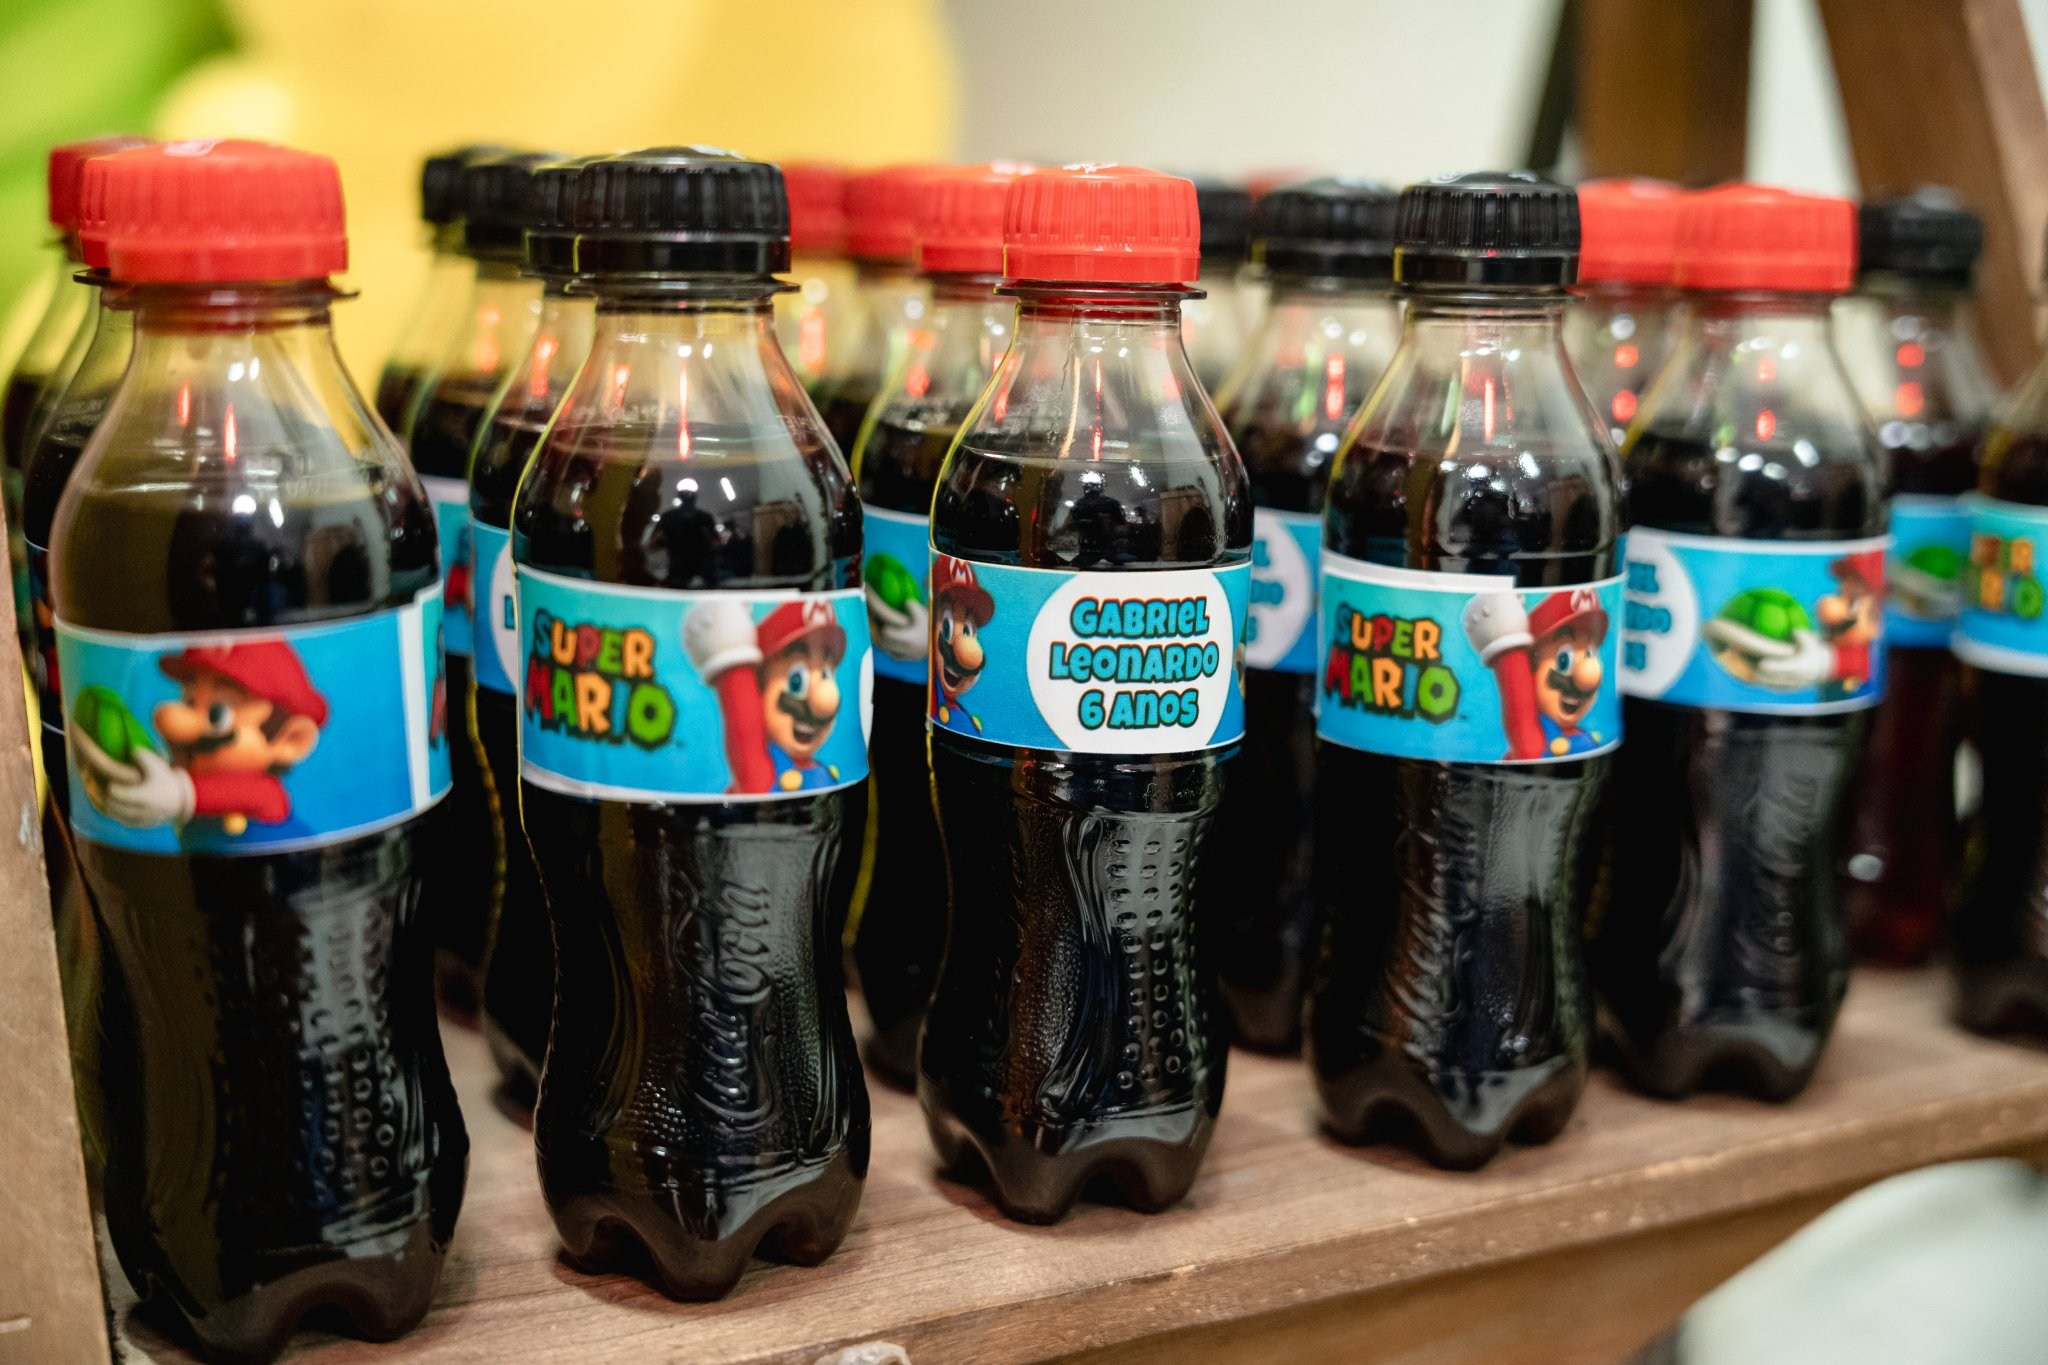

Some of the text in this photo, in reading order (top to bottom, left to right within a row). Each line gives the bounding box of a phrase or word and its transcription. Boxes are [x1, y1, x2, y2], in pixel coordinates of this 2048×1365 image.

[531, 607, 657, 680] SUPER
[1330, 602, 1443, 662] SUPER
[525, 654, 677, 752] MARIO
[1078, 689, 1105, 731] 6
[1324, 643, 1461, 725] MARIO
